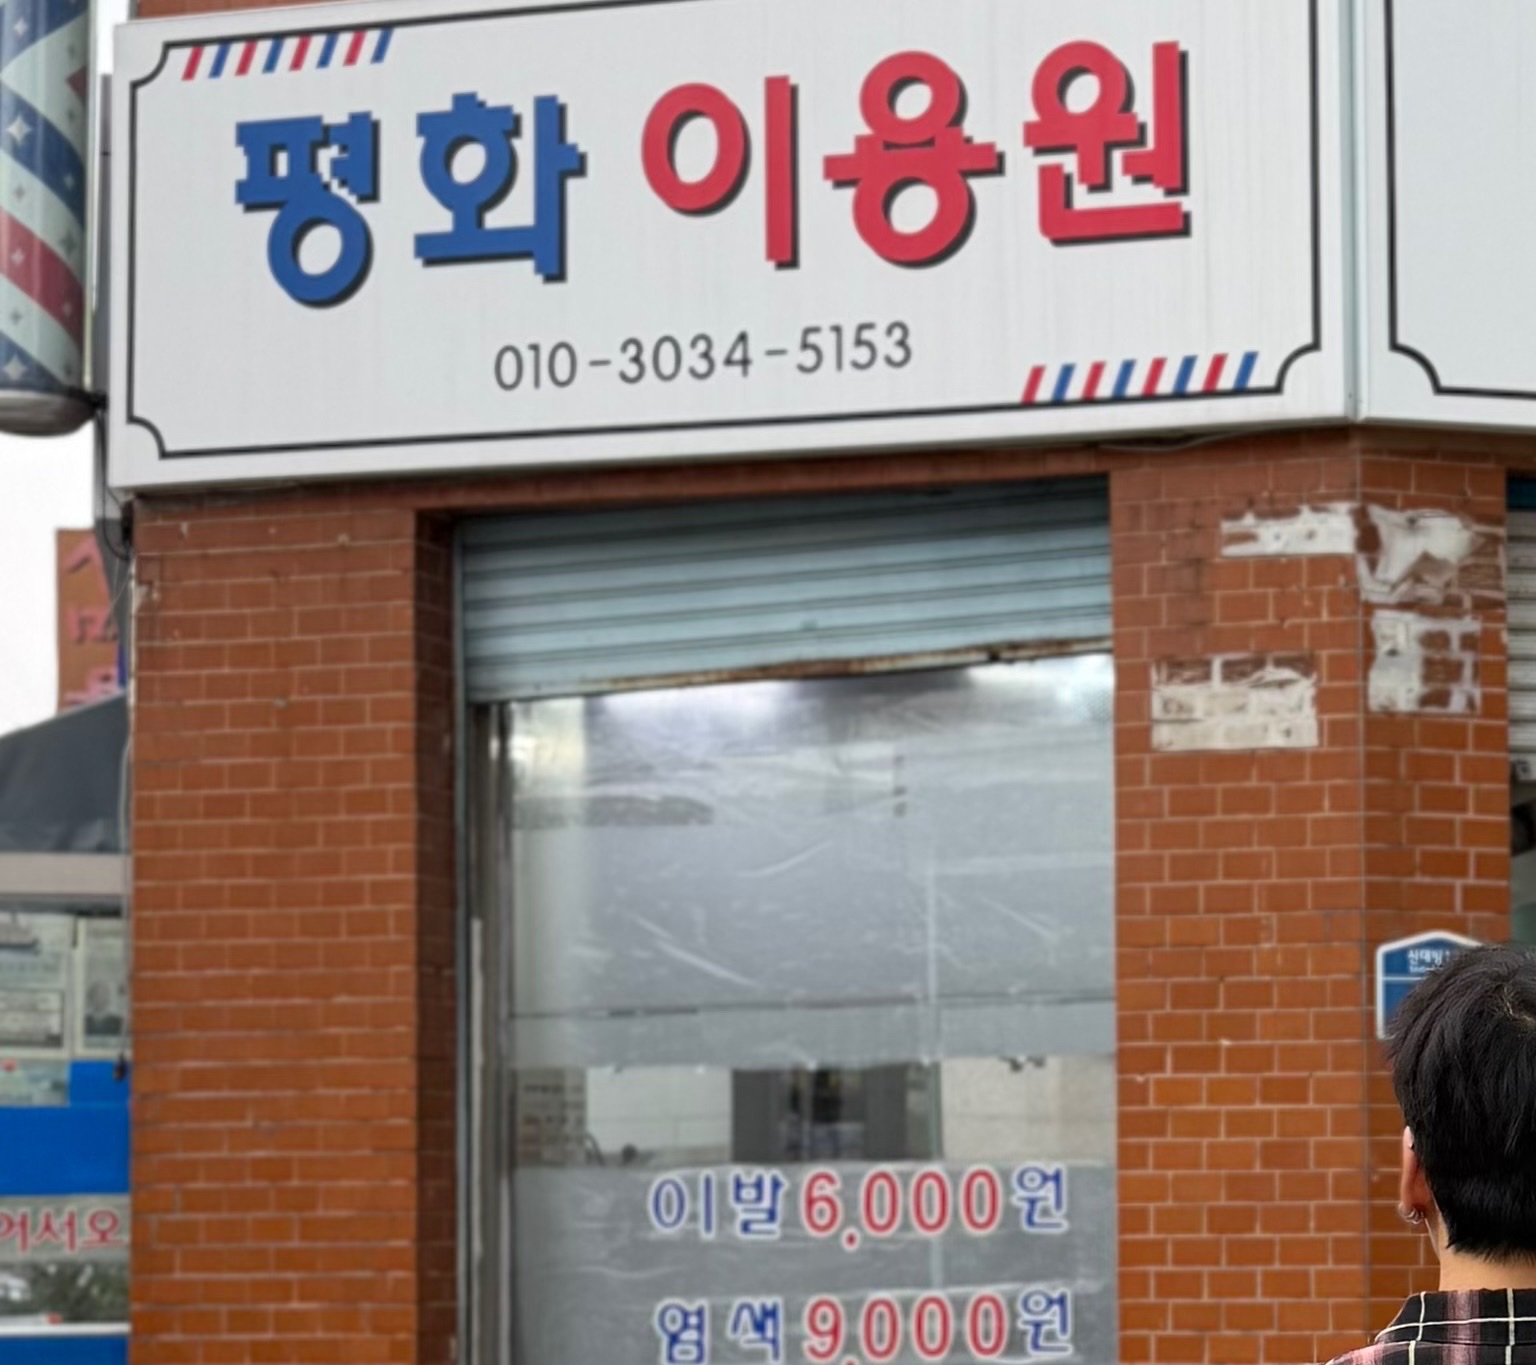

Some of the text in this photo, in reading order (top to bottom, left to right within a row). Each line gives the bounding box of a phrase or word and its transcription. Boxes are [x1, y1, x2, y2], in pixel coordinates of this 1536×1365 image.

[235, 38, 1193, 308] 평화 이용원
[493, 321, 913, 391] 010-3034-5153
[650, 1169, 787, 1239] 이발
